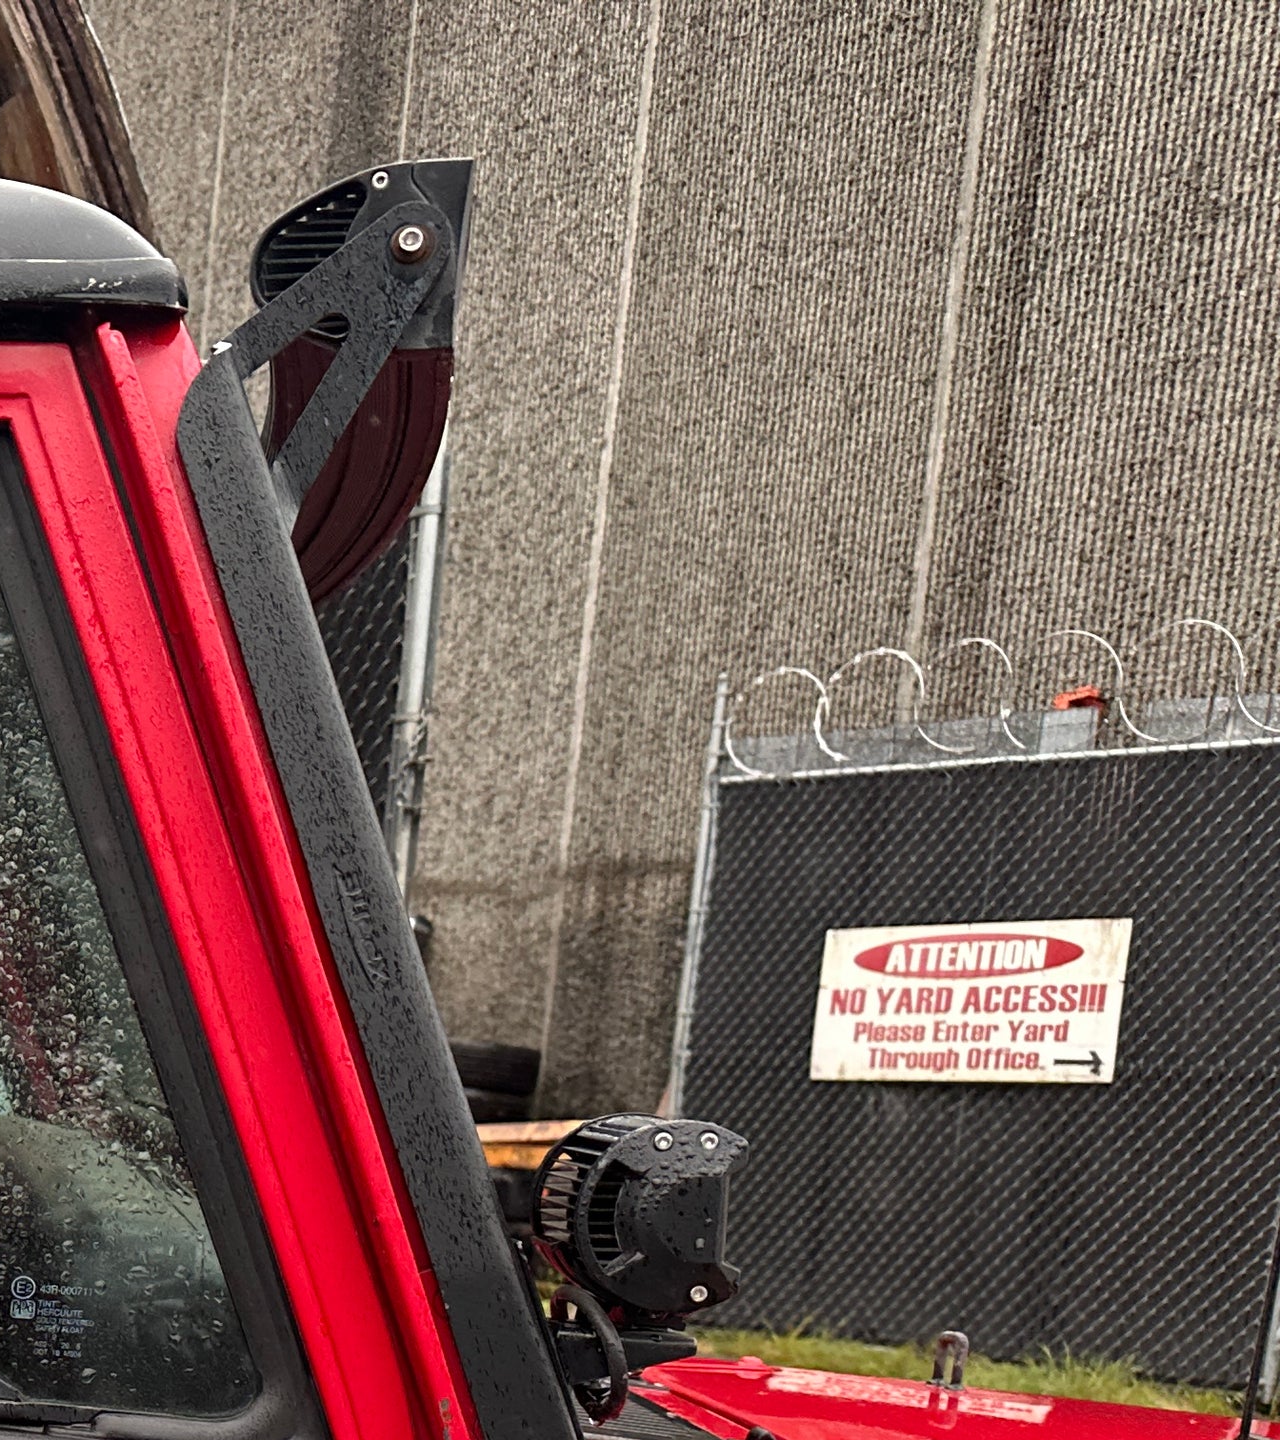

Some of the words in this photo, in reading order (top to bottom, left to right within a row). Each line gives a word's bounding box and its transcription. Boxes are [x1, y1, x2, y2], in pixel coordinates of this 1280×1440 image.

[884, 938, 1048, 974] ATTENTION
[829, 988, 865, 1016] NO
[876, 986, 953, 1015] YARD
[960, 983, 1108, 1015] ACCESS!!!
[853, 1020, 925, 1044] Please
[932, 1021, 999, 1043] Enter
[1008, 1019, 1069, 1043] Yard
[868, 1047, 960, 1074] Through
[966, 1047, 1045, 1072] Office.
